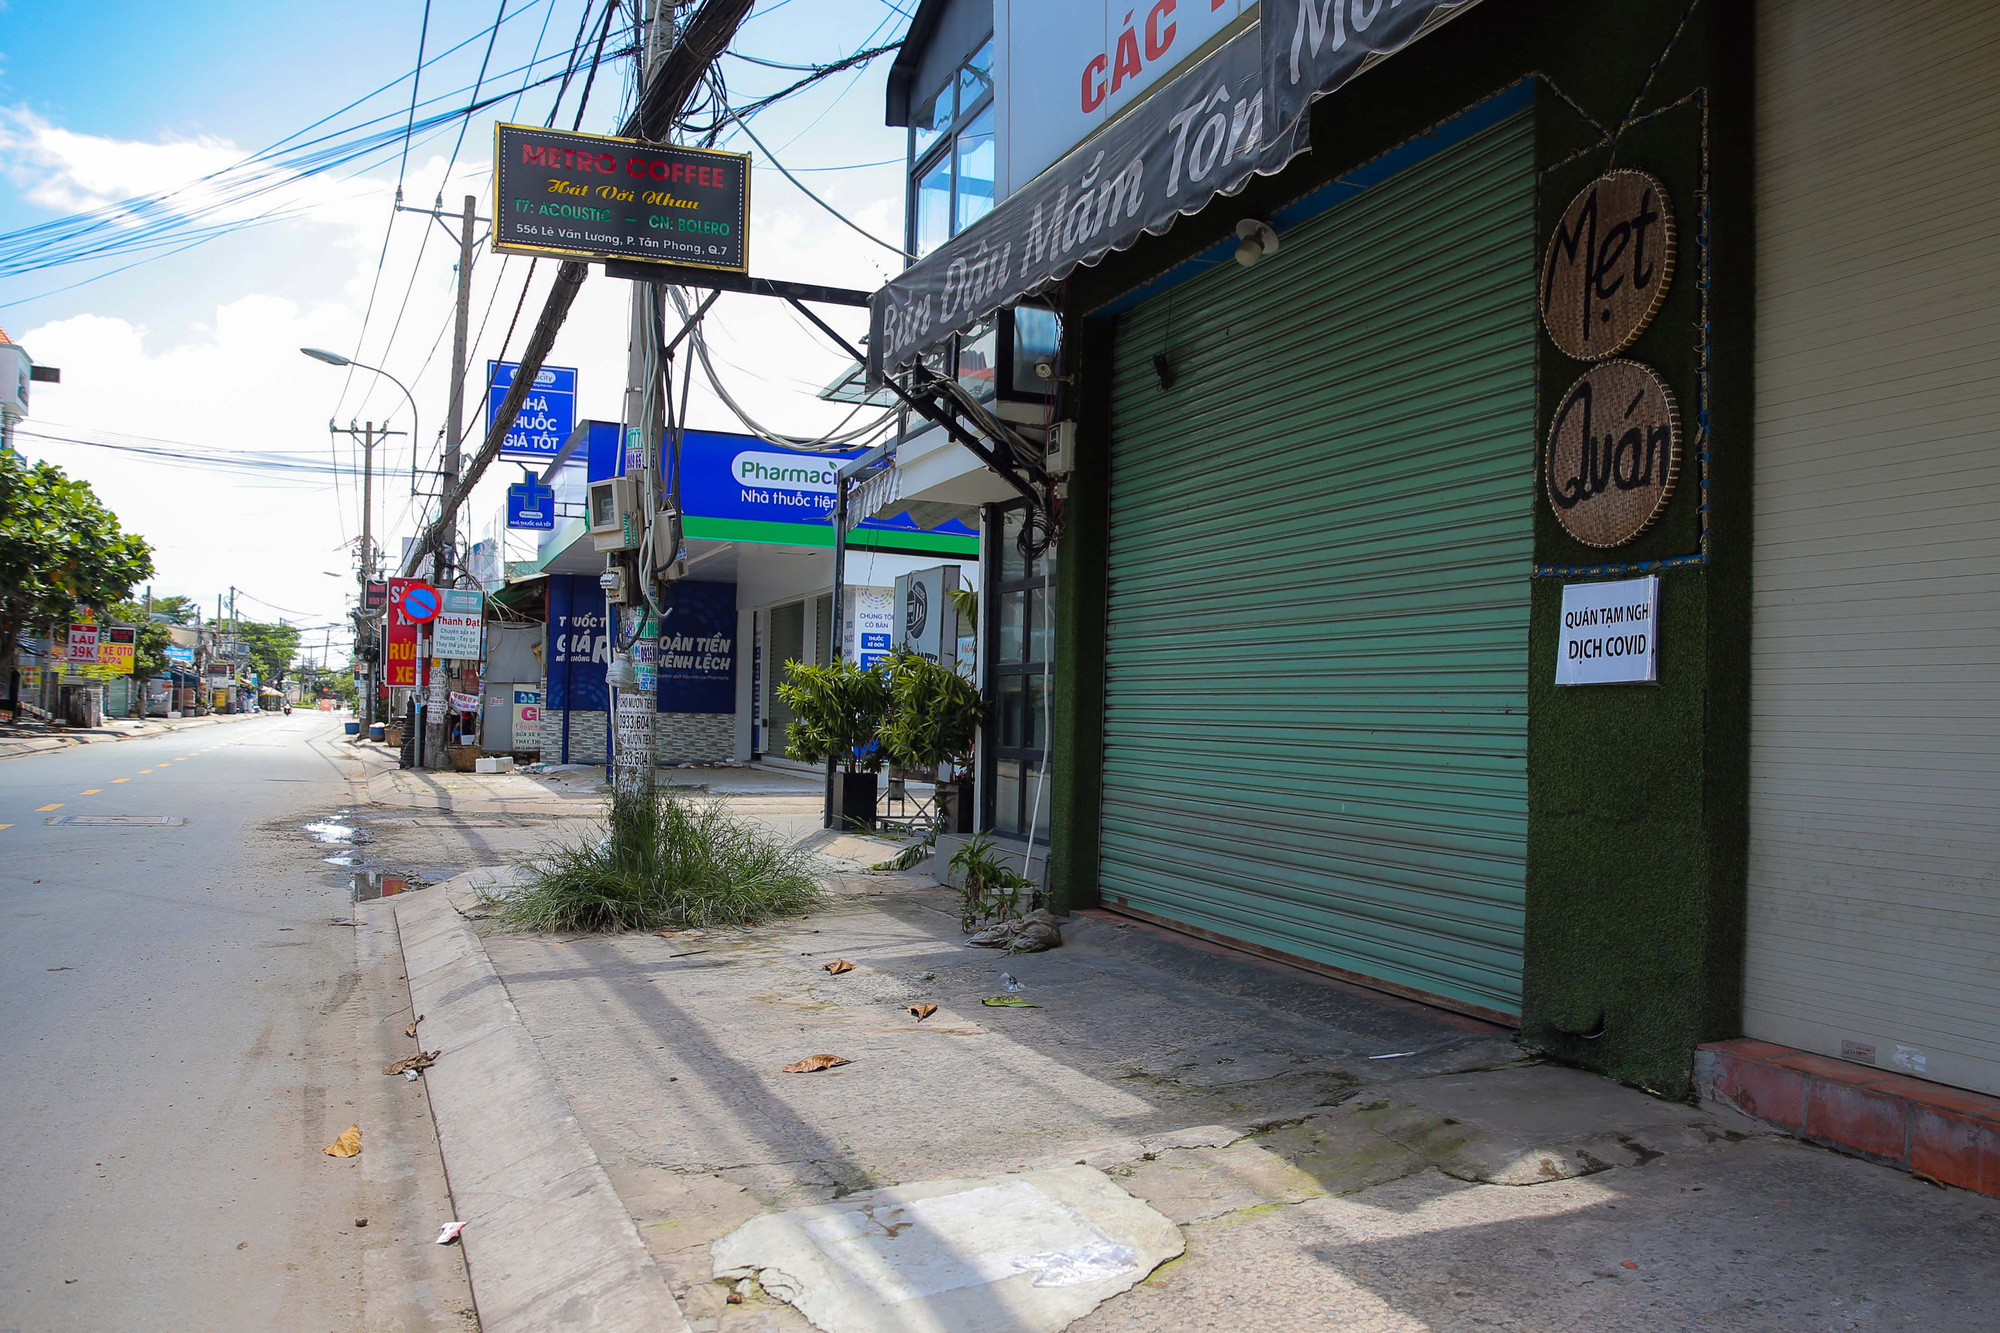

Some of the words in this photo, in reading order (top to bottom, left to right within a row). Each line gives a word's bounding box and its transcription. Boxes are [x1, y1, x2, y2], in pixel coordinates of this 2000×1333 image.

[1081, 0, 1176, 113] CÁC
[523, 144, 616, 174] METRO
[626, 157, 724, 188] COFFEE
[548, 179, 589, 196] Hát
[642, 190, 699, 209] Nhau
[514, 198, 534, 214] T7:
[649, 215, 674, 230] CN:
[678, 218, 730, 236] BOLERO
[516, 224, 538, 235] 556
[541, 227, 554, 237] Lê
[558, 228, 581, 239] Văn
[585, 231, 623, 246] Lương,
[627, 236, 635, 245] P.
[639, 237, 659, 248] Tân
[663, 240, 705, 255] Phong,
[708, 245, 727, 255] Q.7
[883, 290, 931, 358] Bún
[939, 239, 1012, 324] Đậu
[1020, 150, 1144, 278] Mắm
[1545, 187, 1657, 341] Mẹt
[512, 412, 557, 431] HUỐC
[503, 432, 528, 448] GIÁ
[532, 431, 559, 450] TỐT
[1549, 389, 1670, 509] Quán
[741, 461, 856, 491] Pharmaciy
[741, 489, 769, 504] Nhà
[773, 491, 810, 507] thuốc
[437, 616, 463, 626] Thành
[465, 617, 480, 629] Đạt
[559, 612, 598, 627] TUỐC
[1565, 607, 1598, 629] QUÁN
[1600, 606, 1623, 628] TẠM
[1626, 603, 1649, 622] NGH
[71, 645, 94, 658] 39K
[103, 646, 114, 655] XE
[660, 632, 694, 652] OÀN
[697, 632, 731, 653] TIỀN
[1568, 639, 1602, 664] DỊCH
[1605, 634, 1646, 657] COVID
[395, 666, 414, 683] XE
[695, 653, 731, 673] LỆCH
